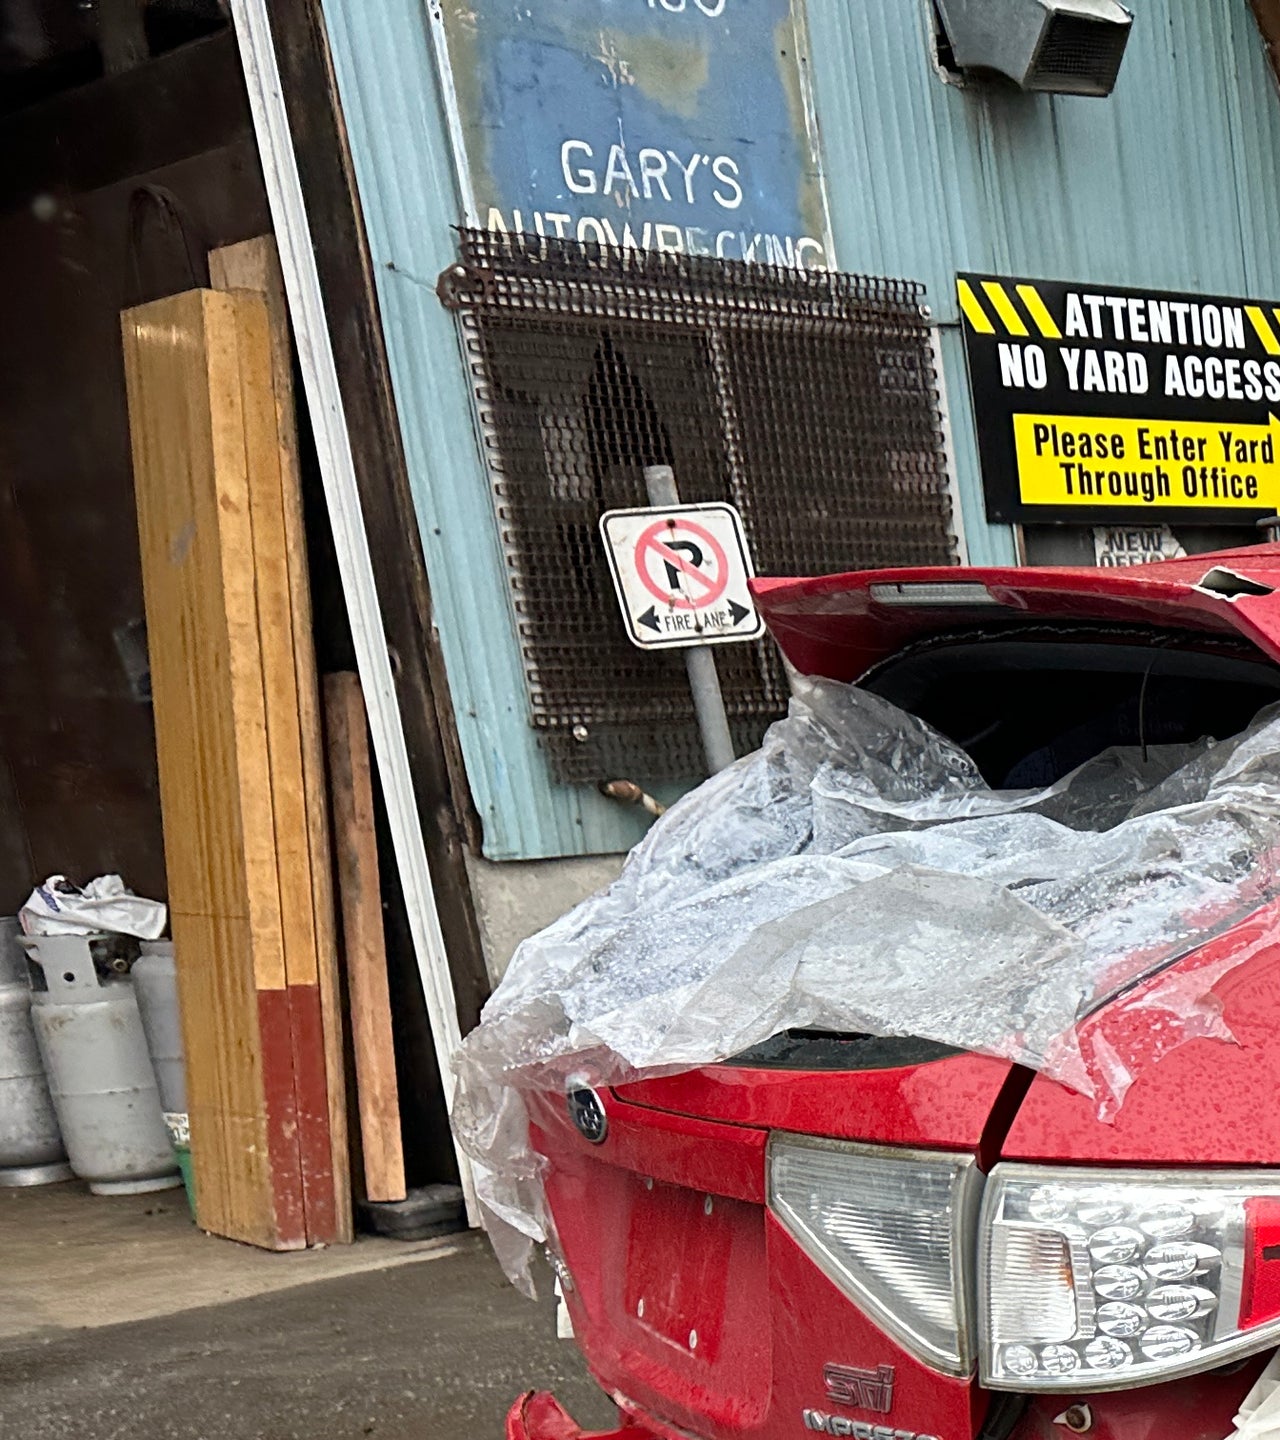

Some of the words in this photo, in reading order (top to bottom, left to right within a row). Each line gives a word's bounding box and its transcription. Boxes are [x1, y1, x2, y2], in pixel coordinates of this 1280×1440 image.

[561, 139, 743, 210] GARY'S
[1065, 293, 1246, 350] ATTENTION
[998, 342, 1048, 390] NO
[1058, 346, 1149, 395] YARD
[1033, 422, 1125, 460] Please
[1137, 427, 1208, 462] Enter
[1218, 430, 1275, 465] Yard
[1058, 462, 1171, 503] Through
[1182, 465, 1259, 499] Office
[1104, 527, 1163, 552] NEW
[664, 613, 693, 632] FIRE
